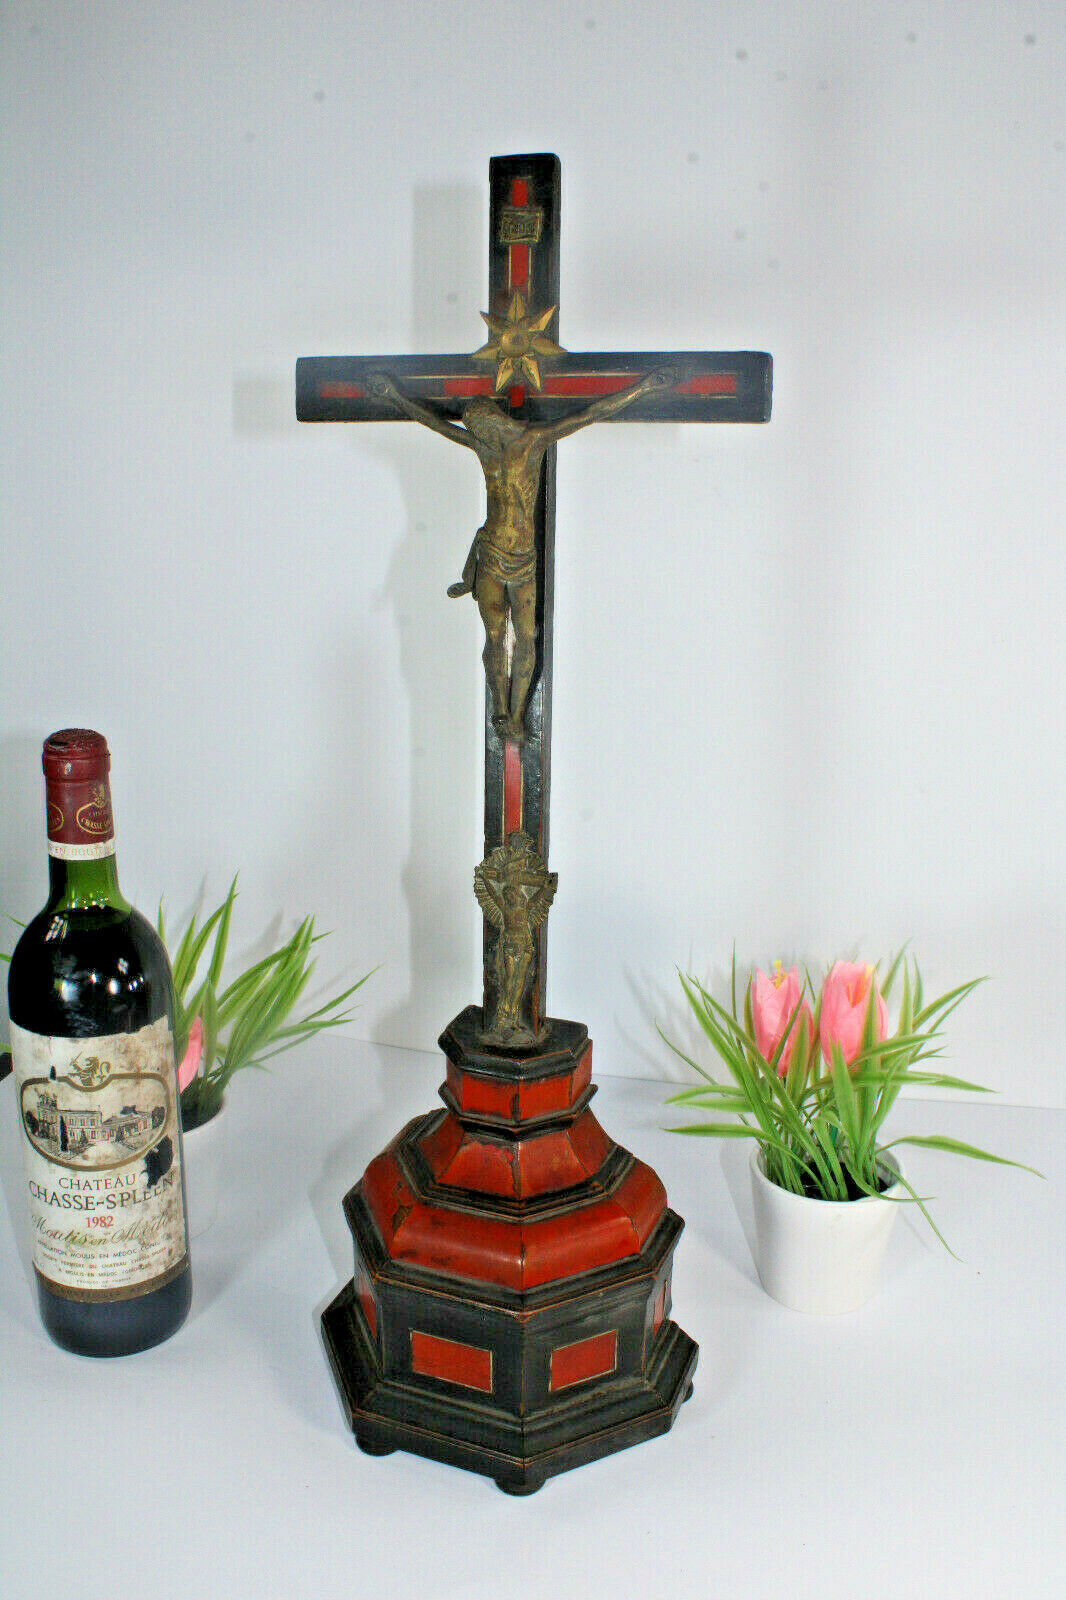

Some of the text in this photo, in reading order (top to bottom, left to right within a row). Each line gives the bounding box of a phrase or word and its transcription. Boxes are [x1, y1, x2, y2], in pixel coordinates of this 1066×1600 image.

[29, 1169, 177, 1211] CHASSE-SPLEEN
[58, 1173, 136, 1191] CHATEAU
[86, 1215, 114, 1228] 1982
